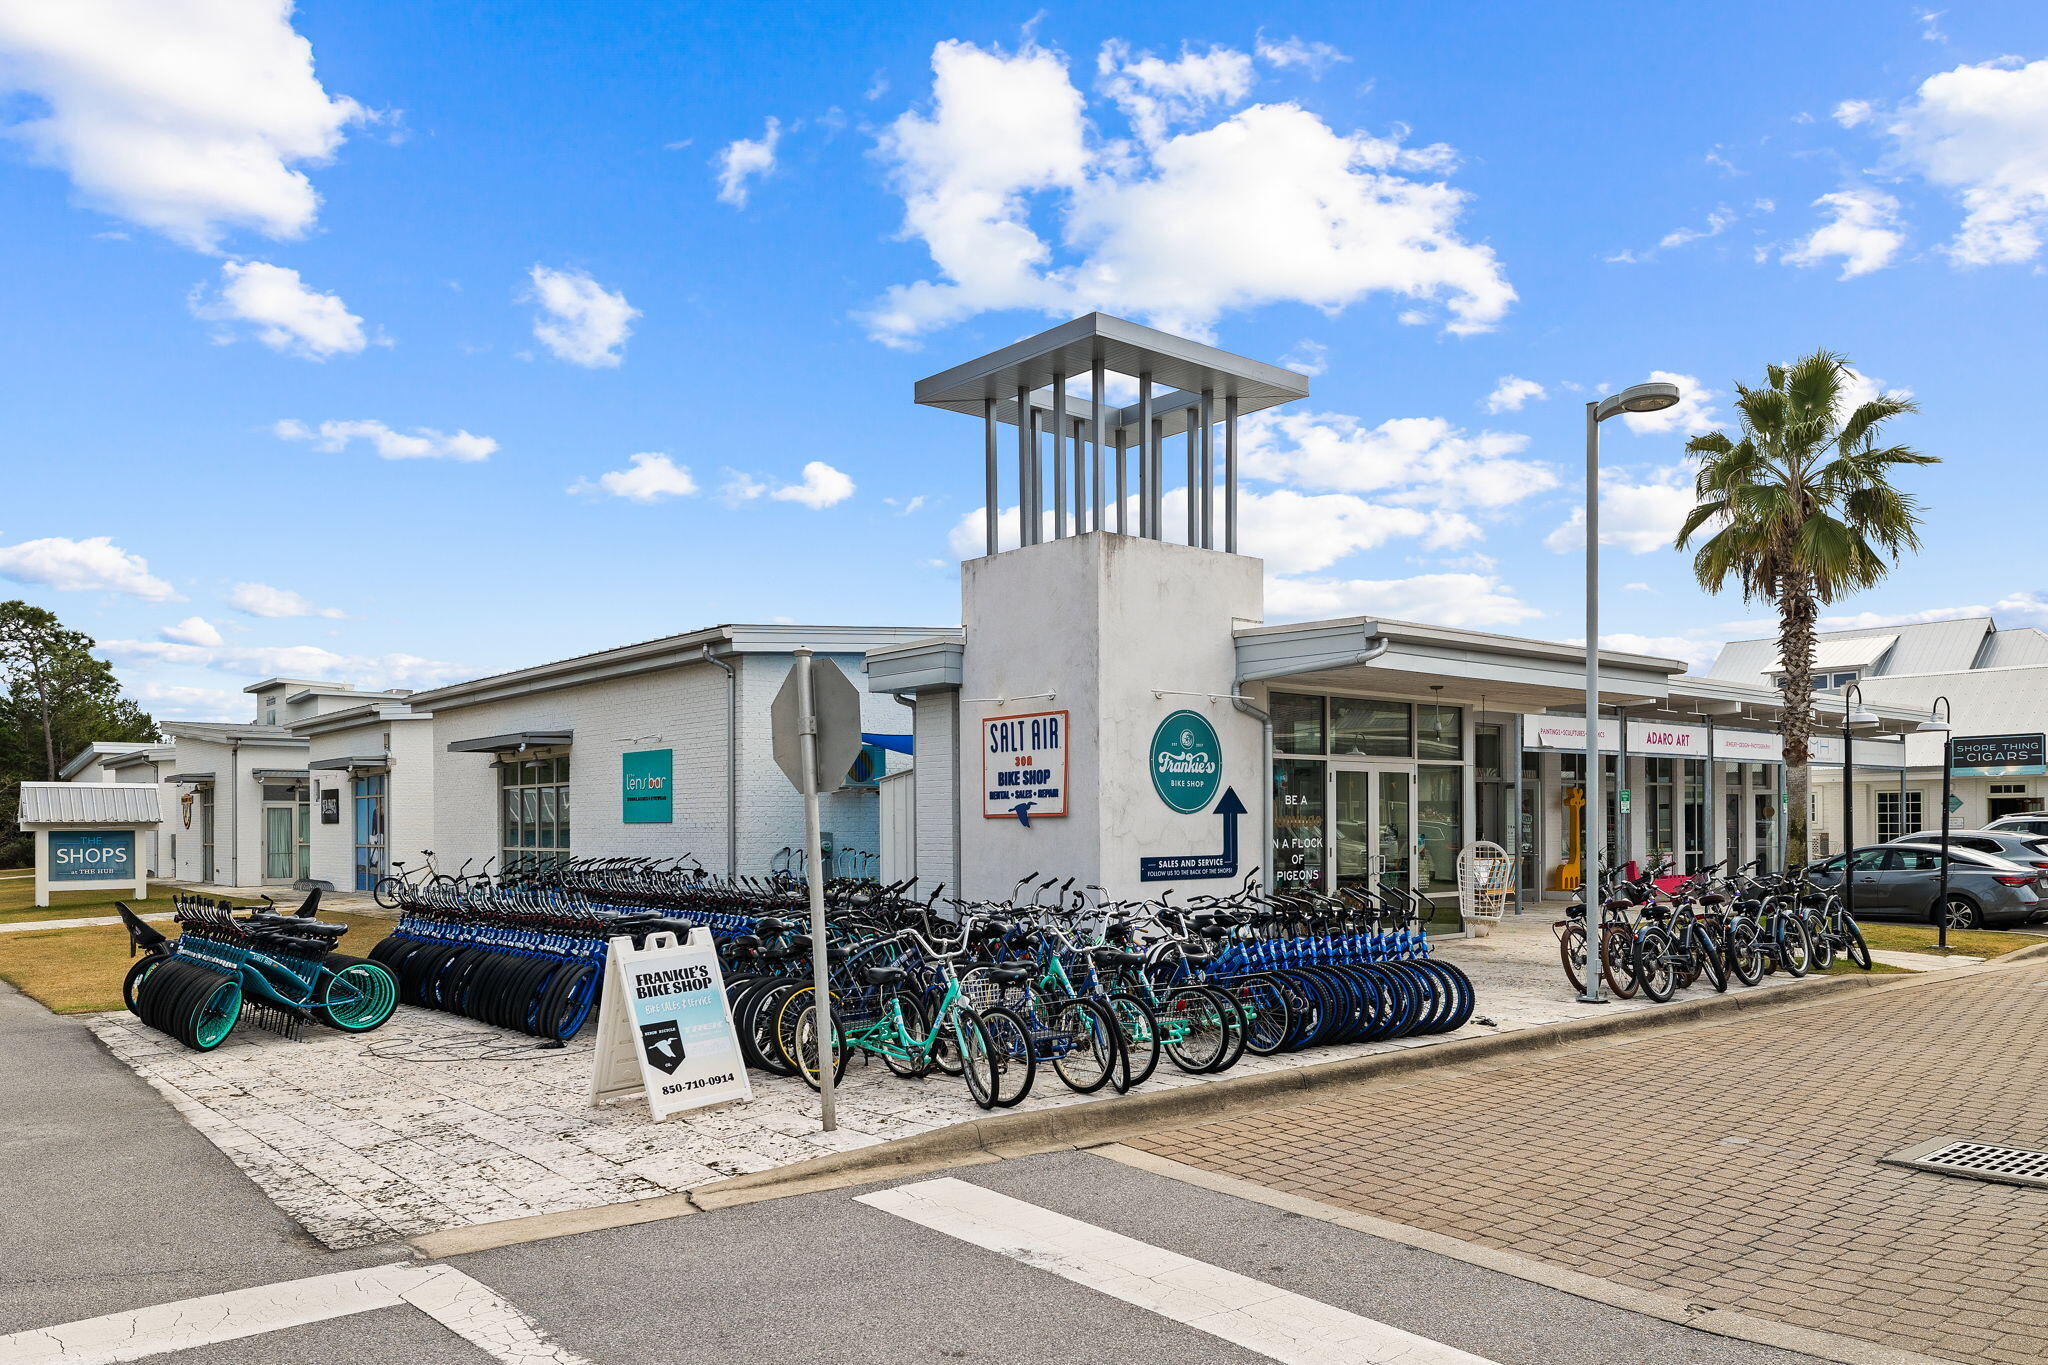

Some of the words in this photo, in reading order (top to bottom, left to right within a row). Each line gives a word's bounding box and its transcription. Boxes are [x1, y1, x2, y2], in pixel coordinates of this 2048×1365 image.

[990, 721, 1024, 753] SALT
[1032, 717, 1058, 750] AIR
[1647, 731, 1673, 745] ADARO
[1676, 733, 1690, 747] ART
[1957, 743, 1997, 752] SHORE
[2001, 742, 2039, 751] THING
[1966, 751, 2029, 762] CIGARS
[998, 771, 1020, 786] BIKE
[1023, 769, 1051, 785] SHOP
[1285, 795, 1298, 805] BE
[1300, 795, 1308, 805] A
[80, 836, 103, 845] THE
[1282, 839, 1289, 849] A
[1291, 838, 1323, 849] FLOCK
[56, 848, 127, 864] SHOPS
[1291, 854, 1304, 865] OF
[1158, 860, 1179, 869] SALES
[1180, 859, 1196, 868] AND
[1197, 858, 1223, 867] SERVICE
[1276, 869, 1319, 882] PIGEONS
[635, 965, 709, 987] FRANKIE'S
[636, 982, 672, 1000] BIKE
[672, 977, 712, 994] SHOP
[662, 1073, 735, 1095] 850-710-0914
